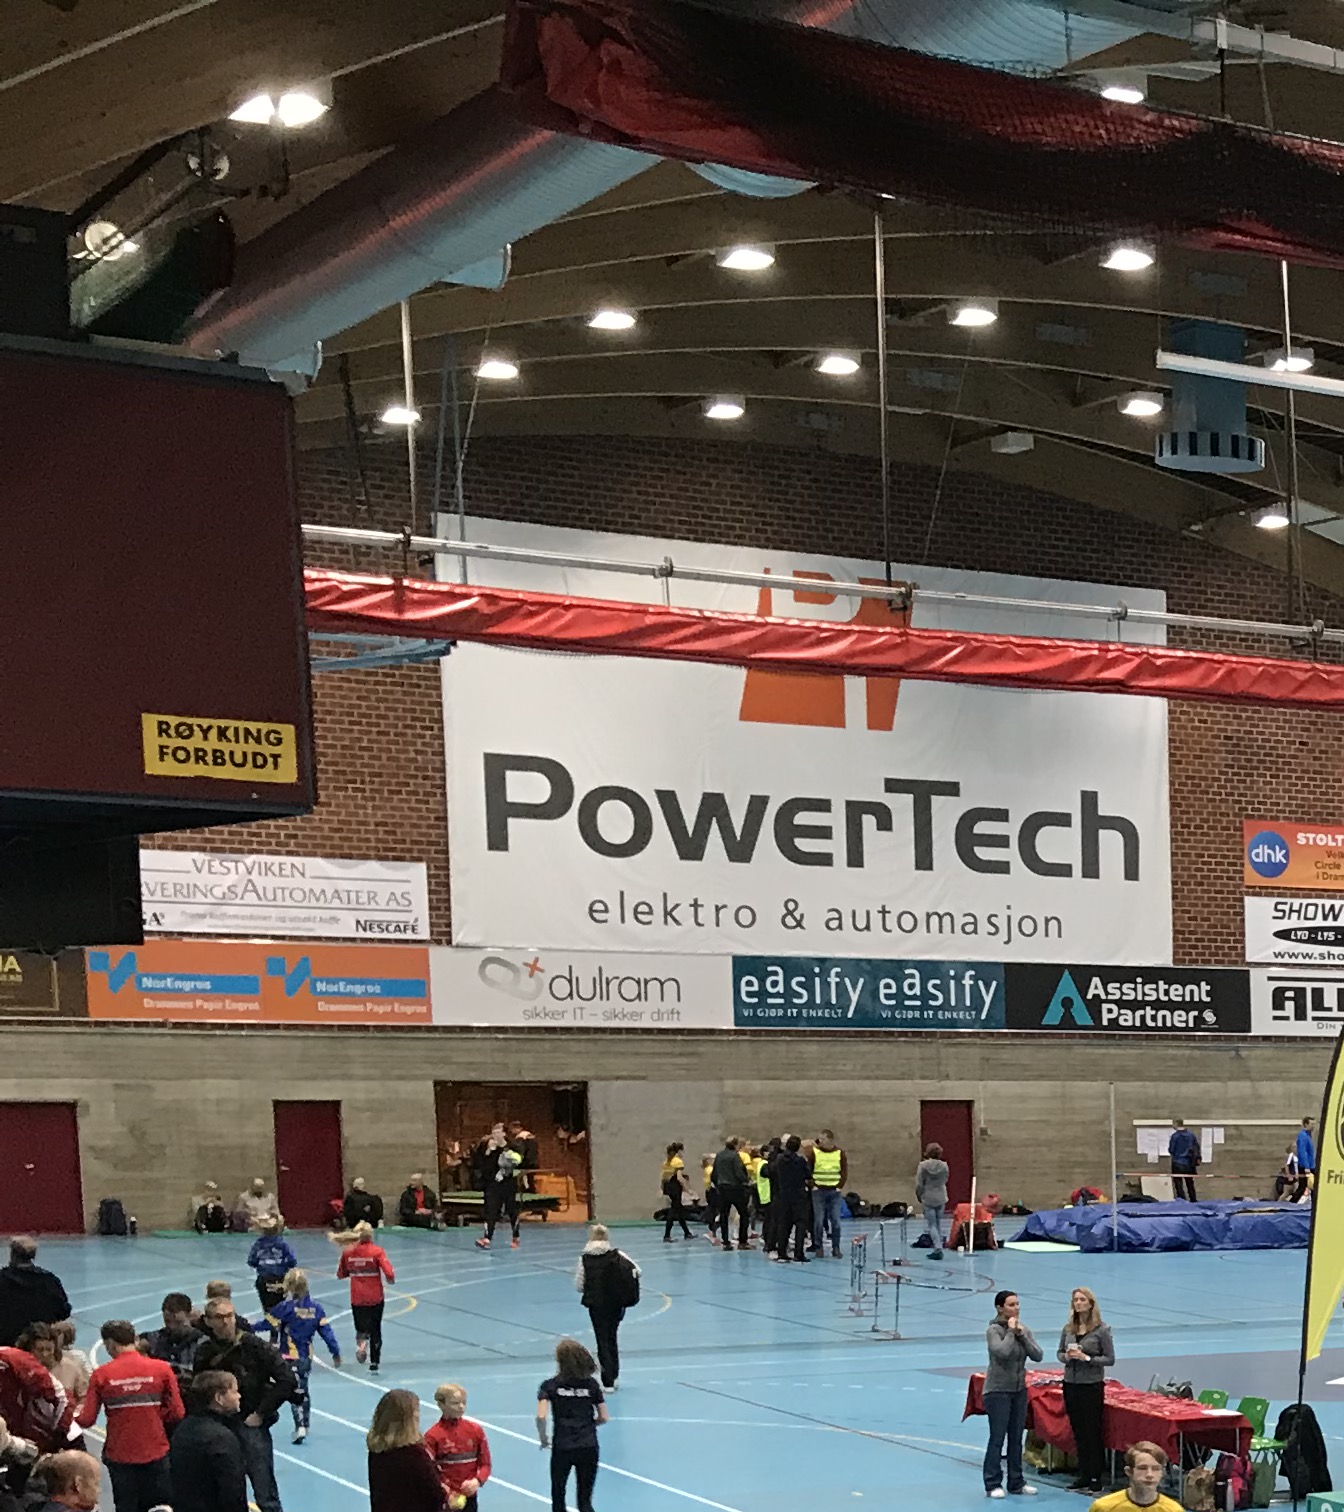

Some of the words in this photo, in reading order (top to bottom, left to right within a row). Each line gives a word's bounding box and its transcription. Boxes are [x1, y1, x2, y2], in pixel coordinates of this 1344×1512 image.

[157, 720, 284, 748] RØYKING
[158, 745, 282, 771] FORBUDT
[483, 752, 1140, 881] PowerTech
[1296, 832, 1344, 848] STOLT
[1251, 844, 1287, 865] dhk
[1314, 860, 1342, 871] Circle
[191, 857, 307, 879] VESTVIKEN
[142, 878, 380, 907] VERINGSAUTOMATER
[385, 890, 412, 908] AS
[355, 918, 420, 936] NESCAFÉ
[588, 889, 758, 929] elektro
[780, 899, 806, 930] &
[825, 905, 1064, 944] automasjon
[1291, 931, 1308, 940] LYD
[1317, 931, 1335, 941] LYS
[549, 965, 682, 1003] dulram
[740, 965, 864, 1019] easify
[878, 967, 997, 1020] easify
[1086, 976, 1212, 1002] Assistent
[522, 1006, 567, 1021] sikker
[572, 1006, 585, 1021] IT
[602, 1007, 646, 1022] sikker
[650, 1008, 681, 1023] drift
[743, 1009, 754, 1017] VI
[787, 1009, 798, 1018] IT
[802, 1009, 843, 1018] ENKELT
[880, 1011, 892, 1019] VI
[923, 1011, 934, 1020] IT
[937, 1011, 976, 1020] ENKELT
[1101, 1006, 1199, 1028] Partner
[1316, 1022, 1336, 1030] DIN
